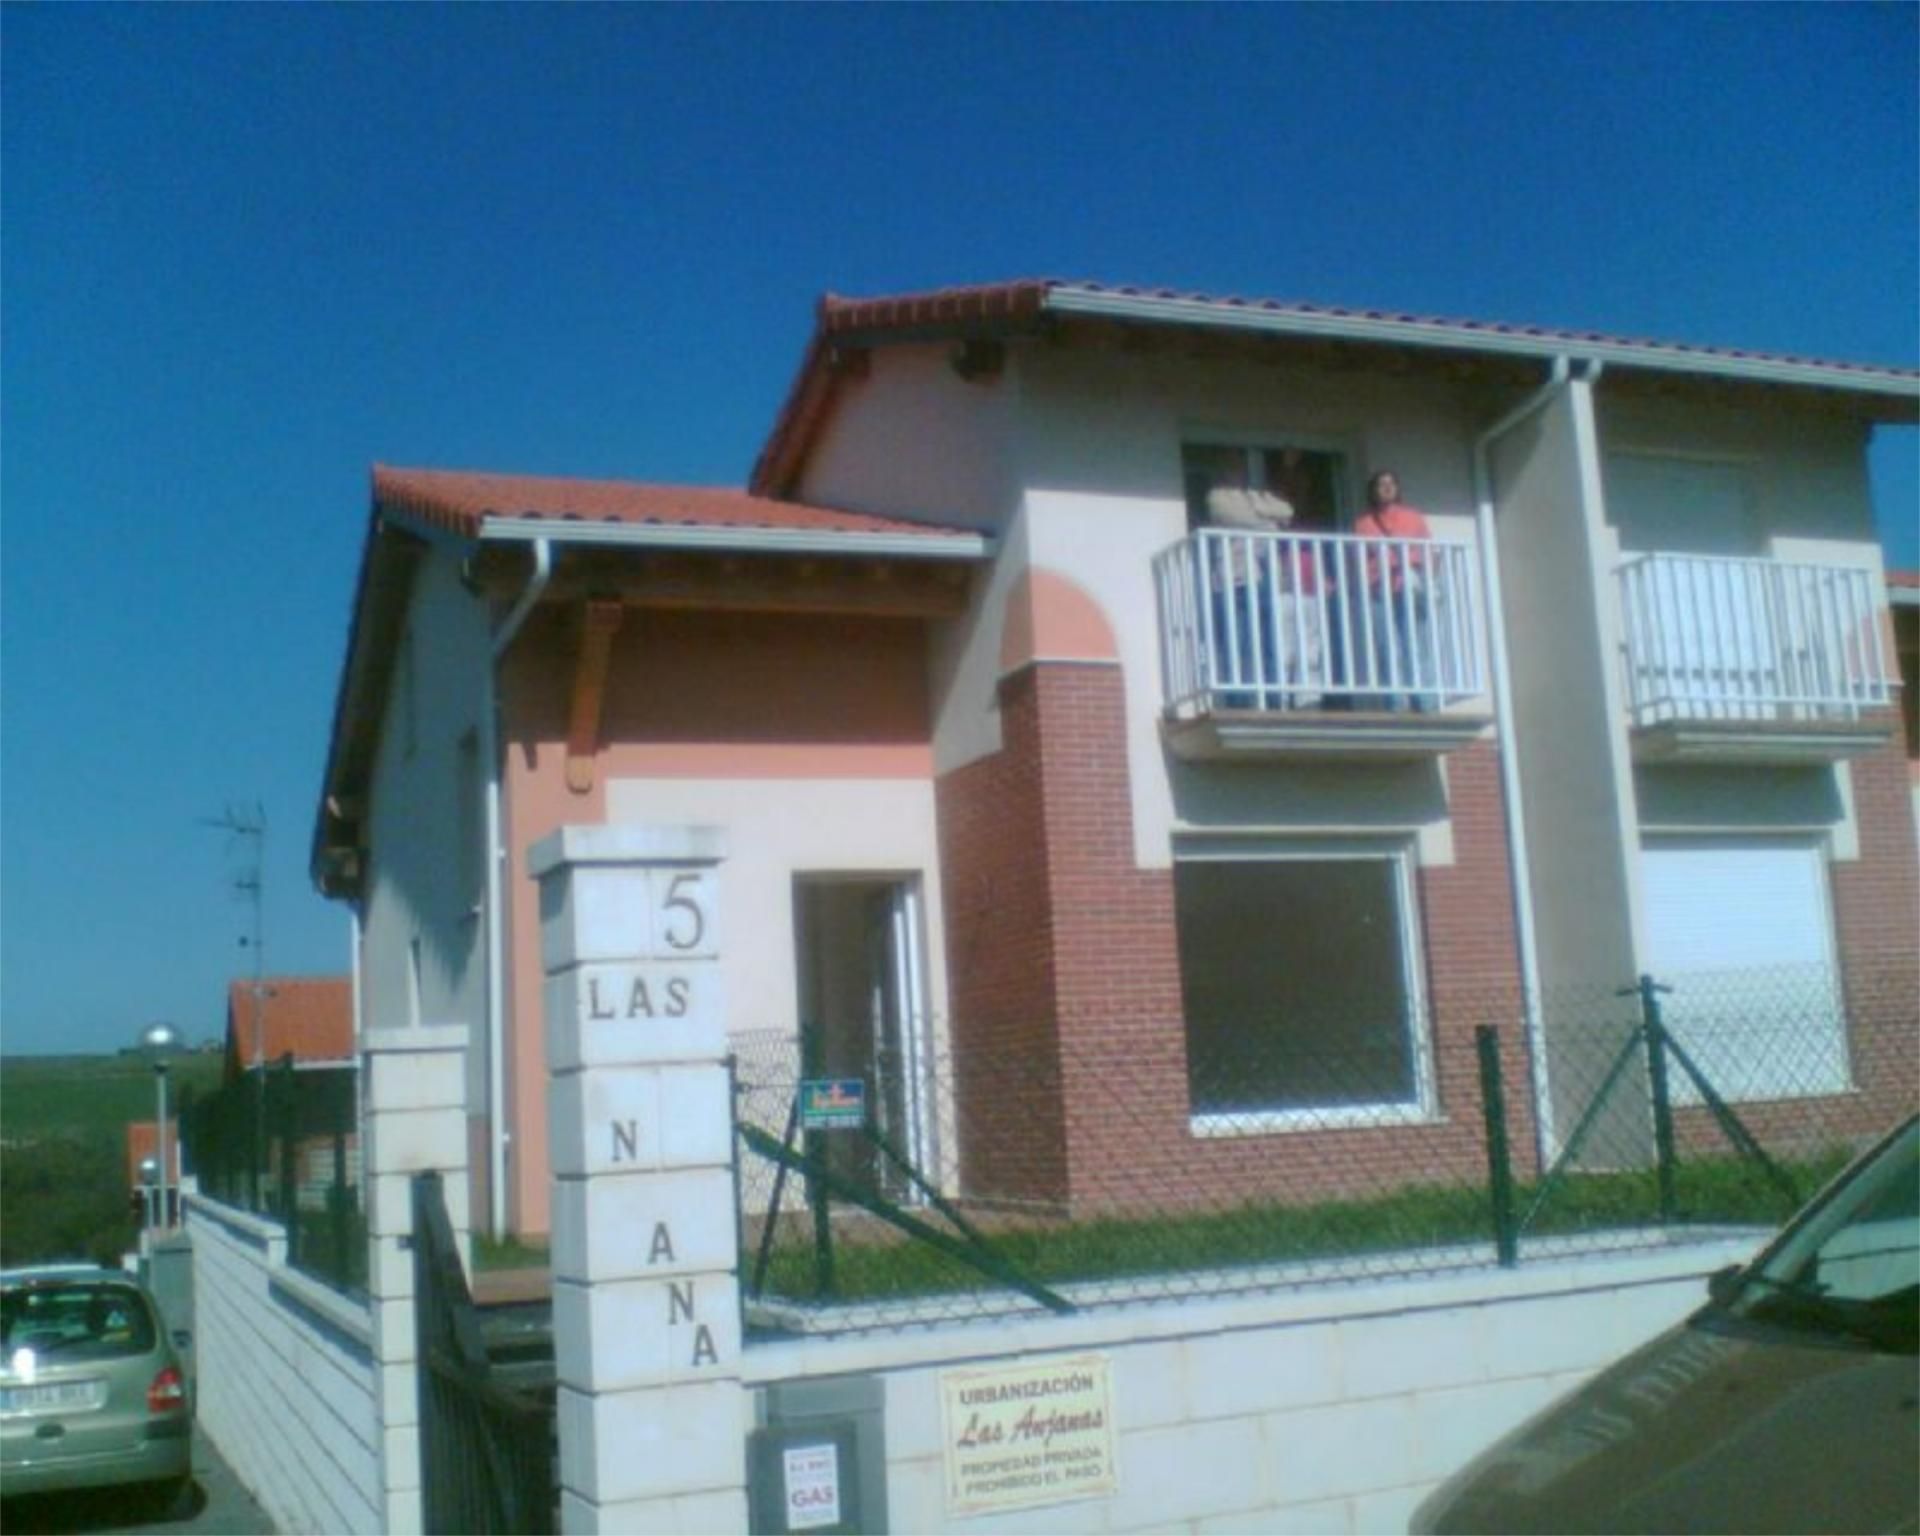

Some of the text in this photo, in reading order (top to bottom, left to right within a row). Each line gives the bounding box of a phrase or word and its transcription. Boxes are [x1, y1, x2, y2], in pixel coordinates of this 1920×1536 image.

[663, 874, 706, 951] 5
[588, 977, 690, 1020] LAS
[959, 1372, 1093, 1405] URBANIZACIÓN
[957, 1411, 1003, 1448] Las
[791, 1486, 835, 1508] GAS
